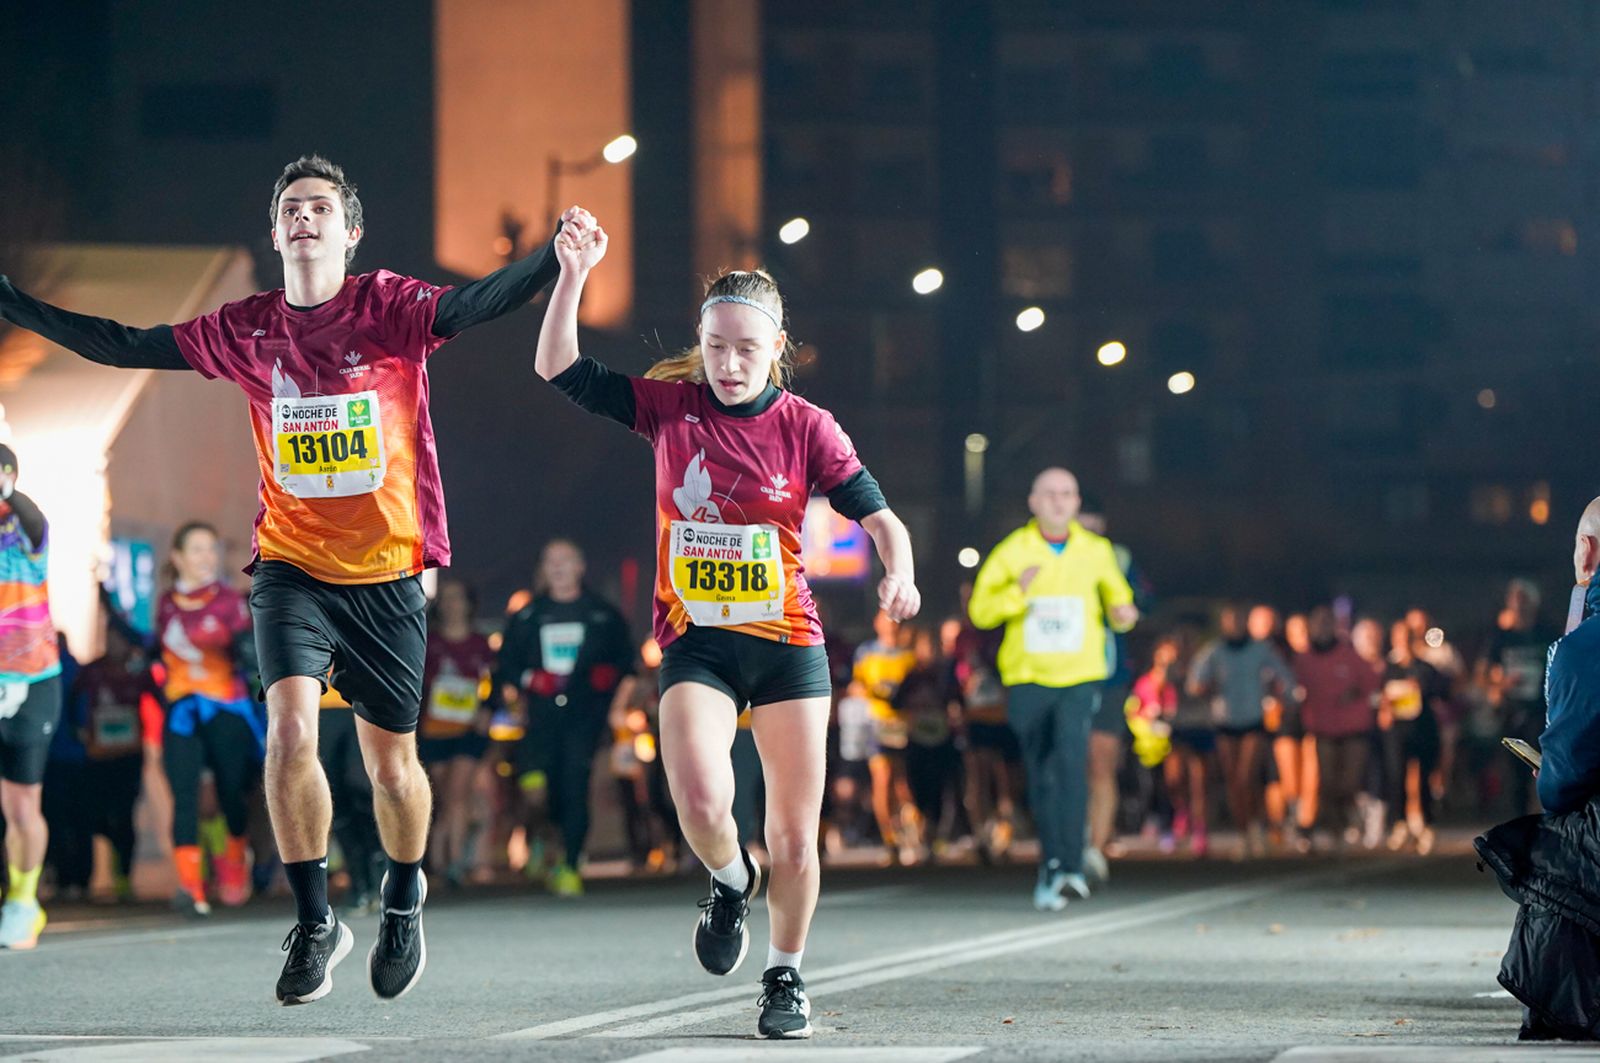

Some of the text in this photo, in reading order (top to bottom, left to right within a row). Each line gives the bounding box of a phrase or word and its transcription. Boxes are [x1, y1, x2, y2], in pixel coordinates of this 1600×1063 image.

[292, 407, 338, 420] NOCHE DE
[282, 421, 302, 433] SAN
[303, 418, 339, 432] ANTÓN
[288, 430, 368, 464] 13104
[696, 535, 743, 547] NOCHE DE
[683, 546, 705, 557] SAN
[706, 548, 743, 560] ANTÓN
[686, 560, 768, 592] 13318
